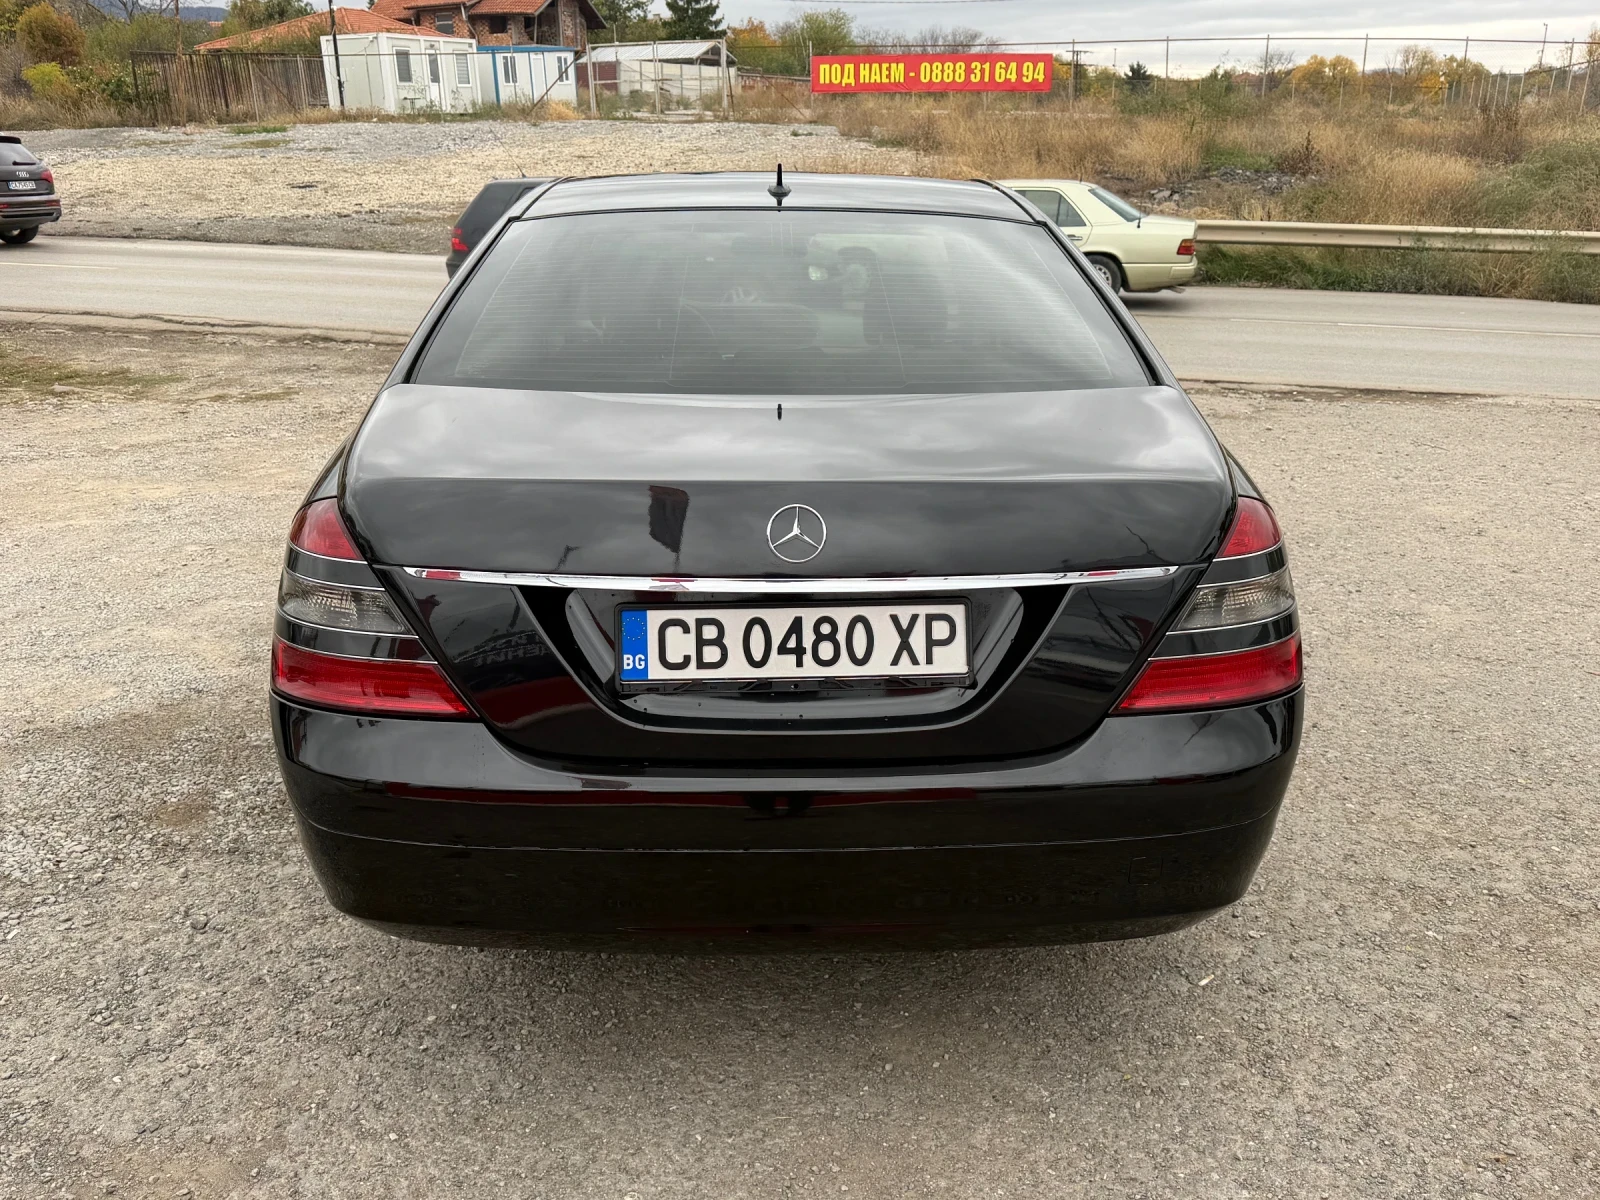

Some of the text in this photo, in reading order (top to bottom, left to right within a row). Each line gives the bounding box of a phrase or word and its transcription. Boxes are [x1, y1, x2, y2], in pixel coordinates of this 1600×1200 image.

[819, 63, 855, 87] ПОД
[859, 62, 905, 84] НАЕМ
[920, 61, 966, 83] 0888
[970, 61, 991, 83] 31
[994, 61, 1018, 83] 64
[1021, 61, 1045, 83] 94
[657, 613, 957, 671] CB 0480 XP
[623, 654, 646, 670] BG
